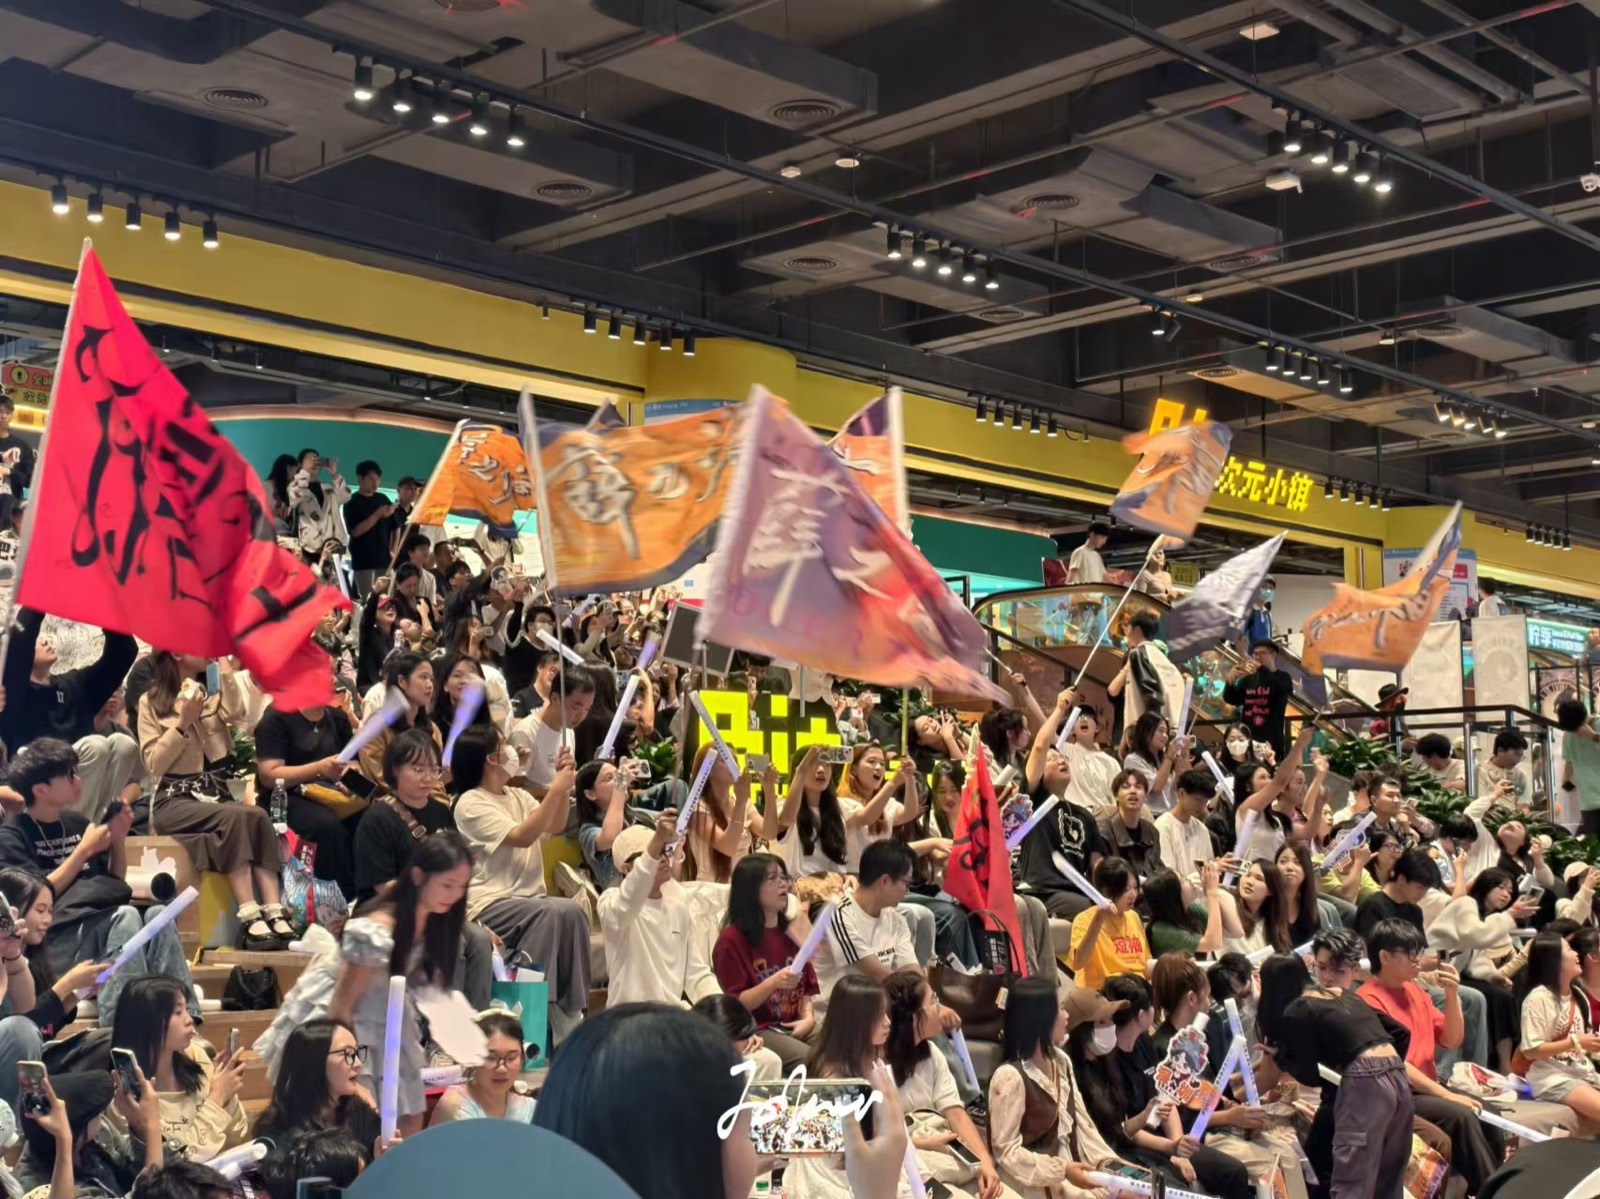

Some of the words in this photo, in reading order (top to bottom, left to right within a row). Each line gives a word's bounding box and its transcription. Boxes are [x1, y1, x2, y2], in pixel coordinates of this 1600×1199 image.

[1215, 456, 1314, 512] 次元小镇
[1111, 935, 1143, 953] 短袖
